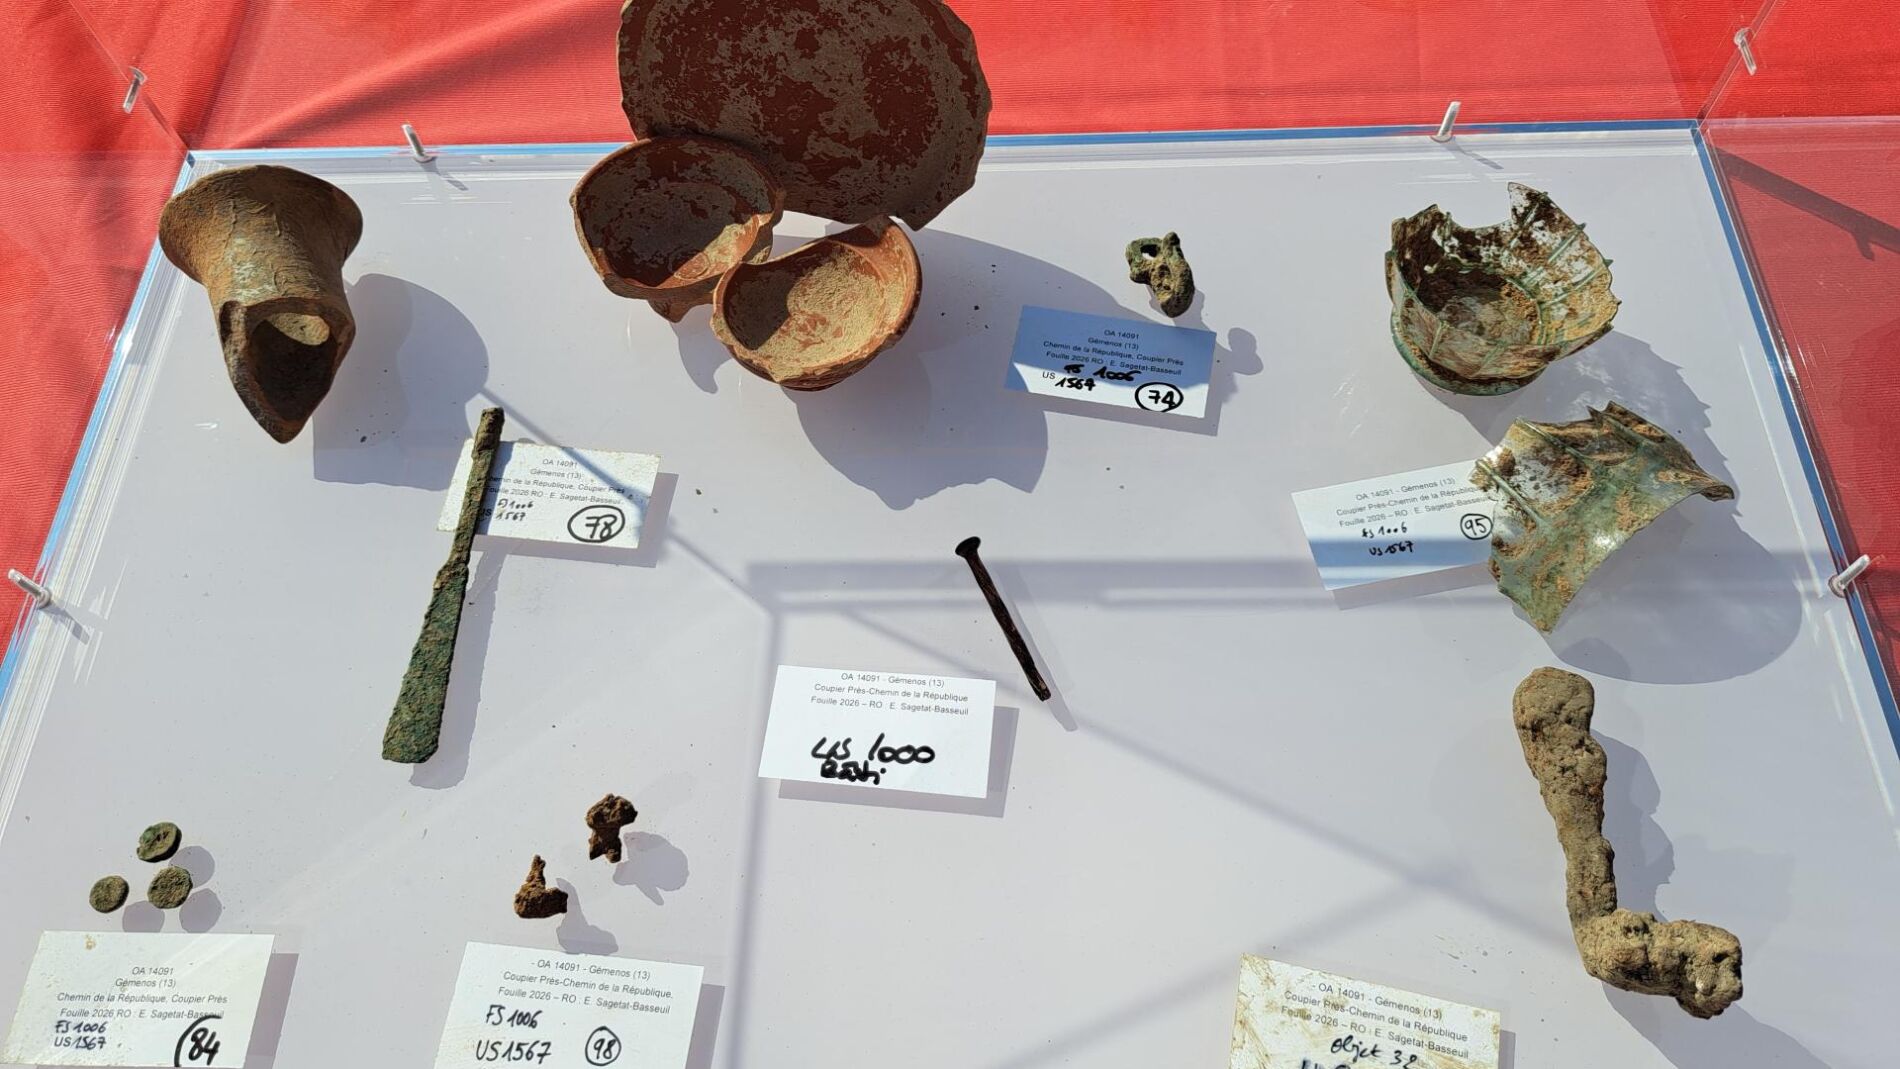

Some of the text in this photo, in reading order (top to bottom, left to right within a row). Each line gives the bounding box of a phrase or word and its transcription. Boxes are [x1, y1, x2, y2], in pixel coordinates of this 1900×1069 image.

[1103, 329, 1140, 340] OA 14091
[1043, 341, 1071, 350] Chemin
[1136, 353, 1165, 363] Coupier
[1167, 357, 1184, 366] Près
[1124, 343, 1139, 351] (13)
[1046, 351, 1070, 360] Fouille
[1071, 355, 1089, 363] 2026
[1091, 357, 1104, 365] RO
[1119, 360, 1182, 375] Sagetat-Basseuil
[1042, 371, 1096, 391] US 1567
[1148, 389, 1176, 409] 74
[542, 458, 554, 466] OA
[530, 490, 544, 498] RO
[578, 483, 607, 493] Coupier
[1356, 493, 1368, 501] OA
[1401, 481, 1438, 493] Gémenos
[1439, 478, 1456, 487] (13)
[1336, 506, 1366, 516] Coupier
[1339, 518, 1365, 528] Fouille
[1367, 513, 1386, 523] 2026
[585, 514, 618, 540] 78
[1464, 517, 1486, 536] 95
[841, 672, 854, 681] OA
[857, 673, 880, 682] 14091
[888, 676, 926, 686] Gémenos
[928, 677, 945, 688] (13)
[814, 683, 846, 693] Coupier
[847, 685, 900, 697] Près-Chemin
[922, 691, 968, 702] République
[811, 695, 837, 706] Fouille
[839, 698, 860, 707] 2026
[869, 700, 883, 709] RO
[901, 702, 969, 715] Sagetat-Basseuil
[867, 732, 935, 765] 1000
[132, 967, 174, 976] OA 14091
[537, 959, 551, 969] OA
[554, 960, 581, 972] 14091
[589, 965, 631, 978] Gémenos
[632, 970, 651, 981] (13)
[114, 978, 176, 988] Gémenos (13)
[503, 971, 537, 983] Coupier
[539, 975, 597, 991] Près-Chemin
[598, 983, 609, 991] de
[57, 992, 91, 1002] Chemin
[93, 993, 105, 1002] de
[107, 994, 115, 1002] la
[171, 994, 206, 1004] Coupier
[207, 994, 228, 1004] Près
[498, 986, 527, 997] Fouille
[529, 990, 551, 1001] 2026
[561, 994, 577, 1004] RO
[596, 997, 671, 1015] Sagetat-Basseuil
[1318, 982, 1333, 994] OA
[1337, 987, 1365, 1001] 14091
[1375, 996, 1421, 1016] Gémenos
[1423, 1008, 1443, 1021] (13)
[60, 1008, 90, 1018] Fouille
[91, 1008, 114, 1018] 2026
[116, 1010, 132, 1018] RO
[1284, 990, 1321, 1006] Coupier
[1388, 1016, 1400, 1025] de
[1402, 1019, 1411, 1029] la
[1414, 1021, 1468, 1042] République
[1281, 1005, 1312, 1020] Fouille
[1315, 1014, 1339, 1027] 2026
[1350, 1022, 1366, 1033] RO
[1388, 1031, 1469, 1059] Sagetat-Basseuil
[188, 1026, 221, 1066] 84
[593, 1038, 617, 1060] 98
